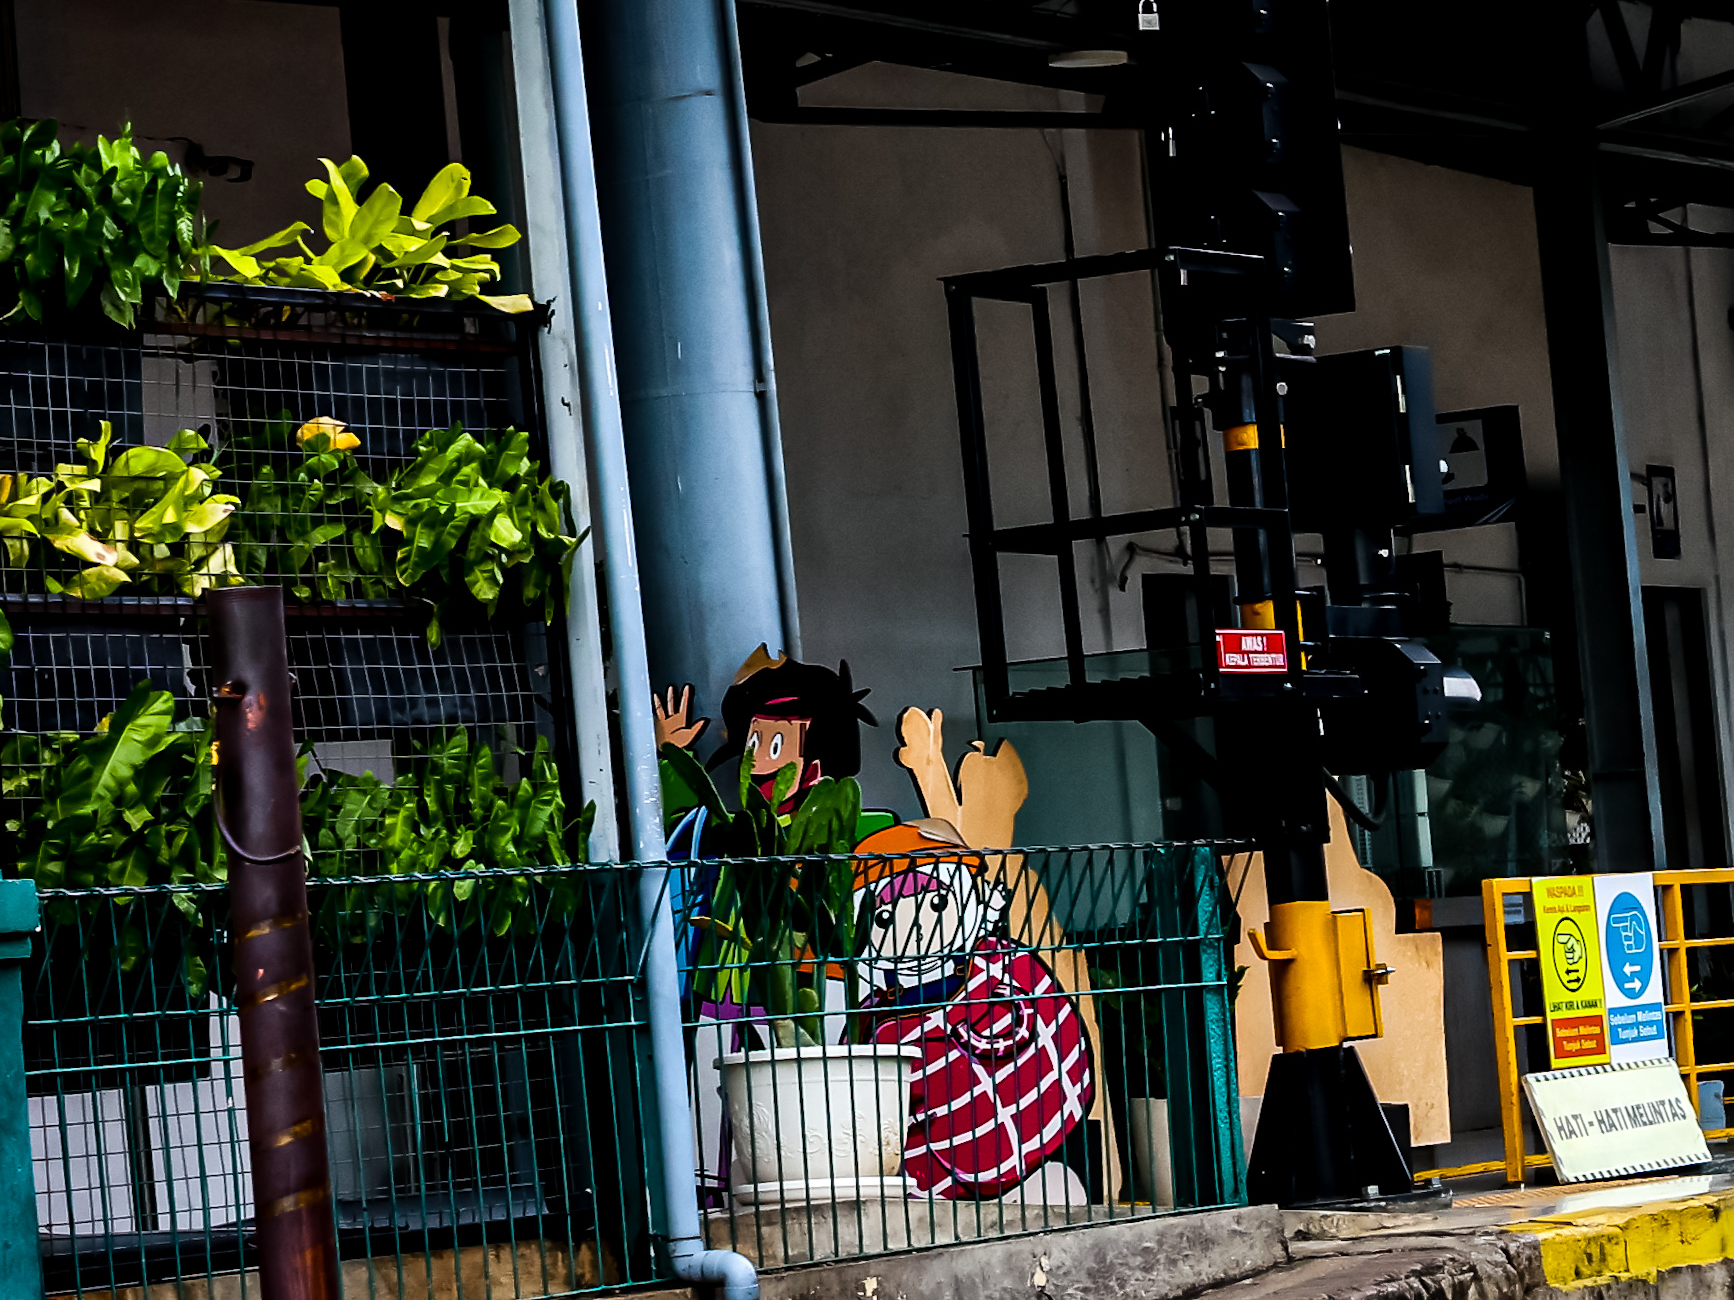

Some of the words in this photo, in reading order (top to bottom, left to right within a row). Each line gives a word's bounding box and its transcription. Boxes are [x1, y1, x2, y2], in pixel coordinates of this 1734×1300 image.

[1610, 1013, 1636, 1026] Sebelum
[1637, 1010, 1662, 1022] Melintas
[1618, 1026, 1638, 1041] Tunjuk
[1639, 1025, 1657, 1036] Sebut
[1553, 1113, 1589, 1141] HATI
[1593, 1105, 1628, 1135] HATI
[1624, 1097, 1687, 1129] MELINTAS
